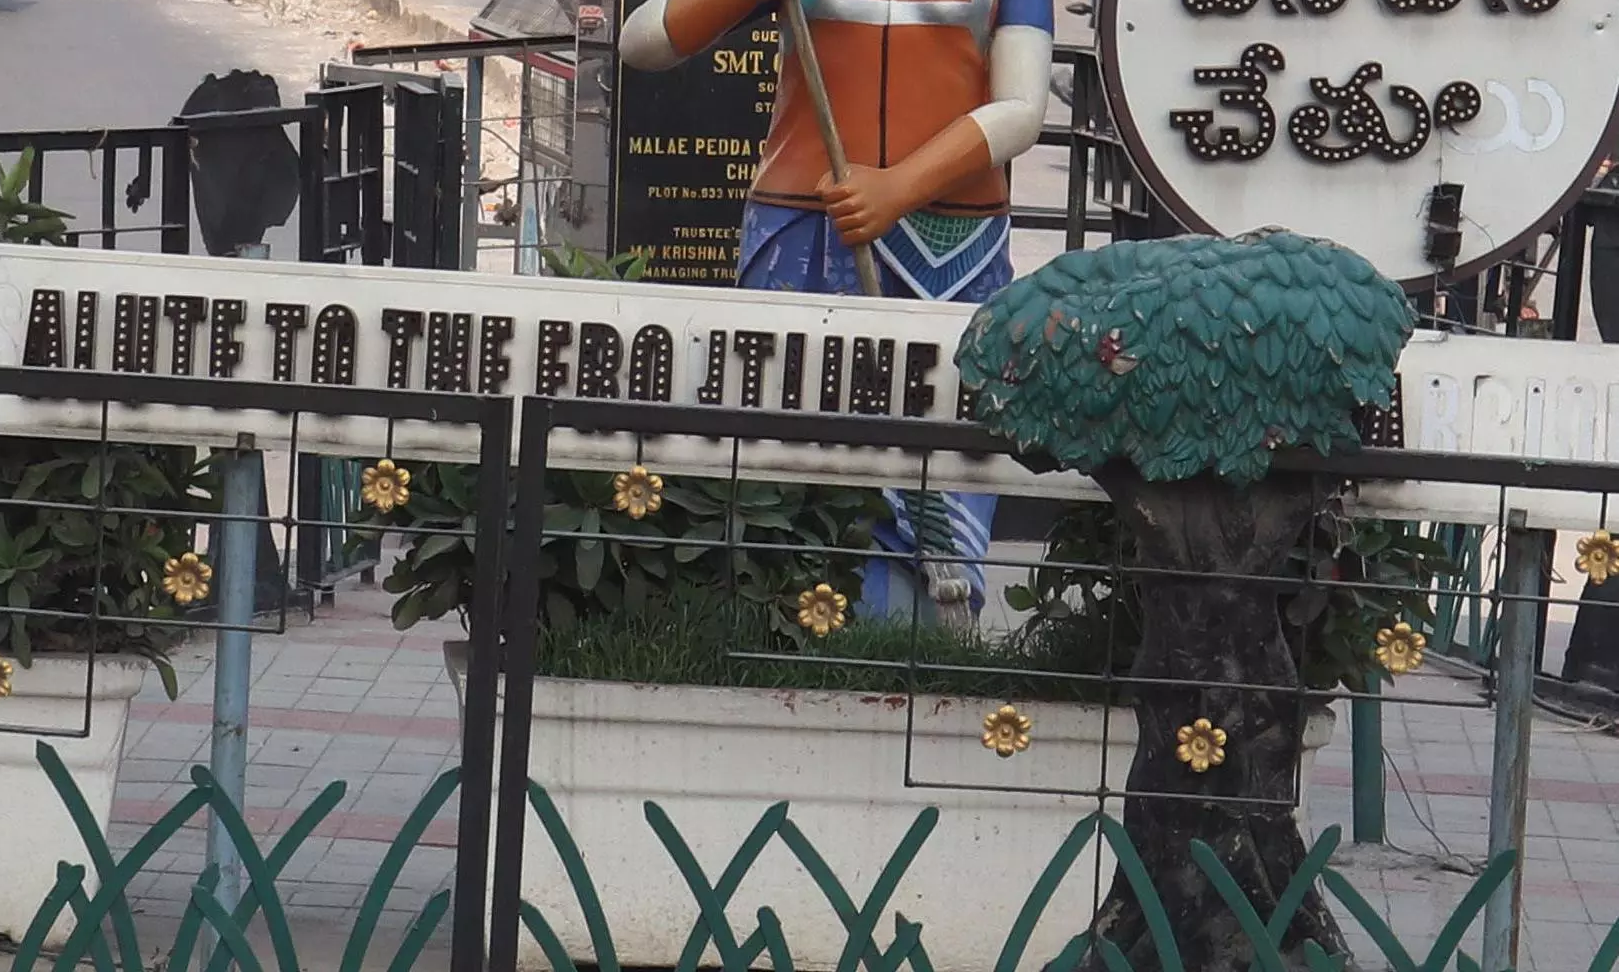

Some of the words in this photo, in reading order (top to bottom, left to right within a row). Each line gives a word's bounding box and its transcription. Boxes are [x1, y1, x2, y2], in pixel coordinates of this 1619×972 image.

[713, 50, 770, 75] SMT.
[629, 137, 689, 155] MALAE
[694, 138, 752, 156] PEDDA
[648, 186, 679, 199] PLOT
[662, 245, 727, 261] KRISHNA
[642, 266, 708, 279] MANAGING
[712, 267, 738, 279] TRU
[381, 307, 514, 394] THE
